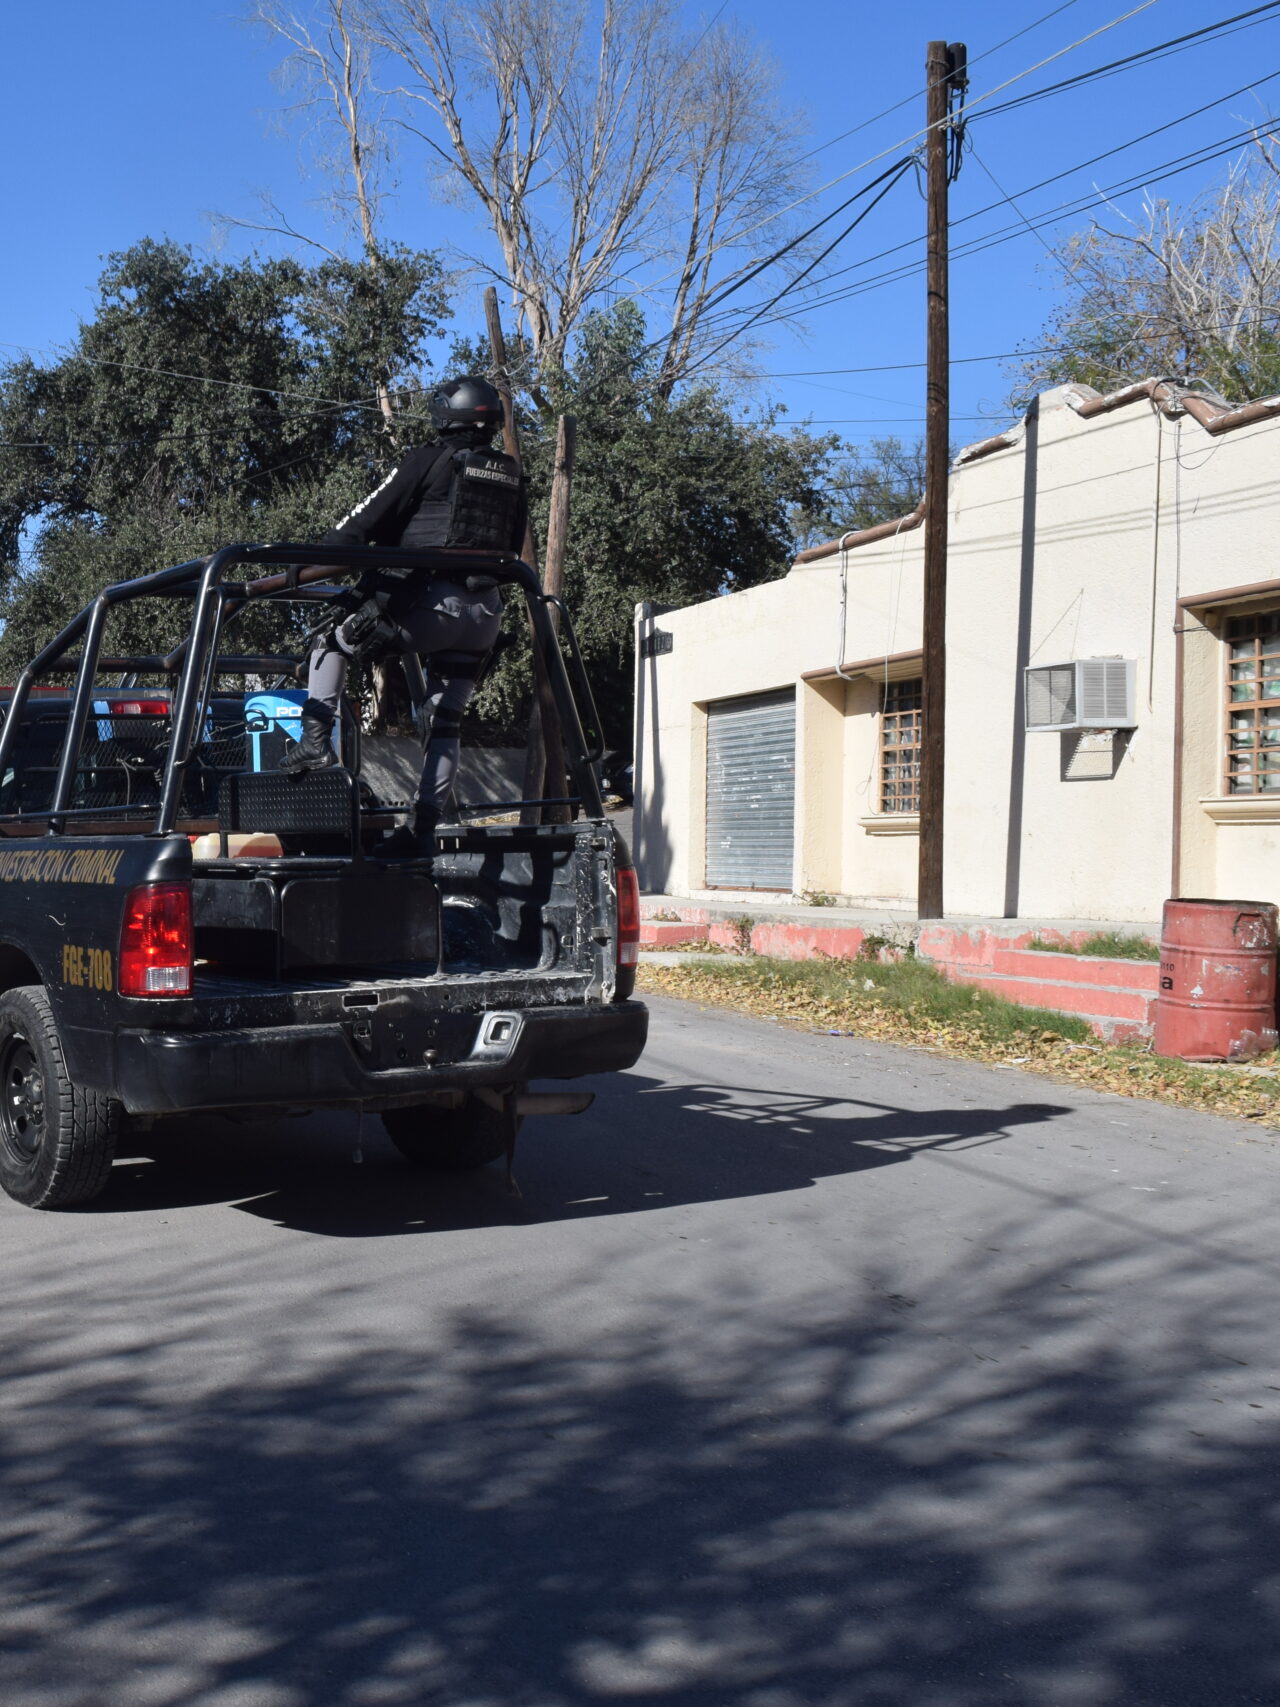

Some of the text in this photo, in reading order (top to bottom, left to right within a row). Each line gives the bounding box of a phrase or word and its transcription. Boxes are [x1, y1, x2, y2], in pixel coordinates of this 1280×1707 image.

[465, 466, 519, 486] FUERZAS ESPECIALES
[276, 706, 304, 717] PO
[63, 849, 125, 885] CRIMINAL
[63, 944, 113, 991] FGE-708
